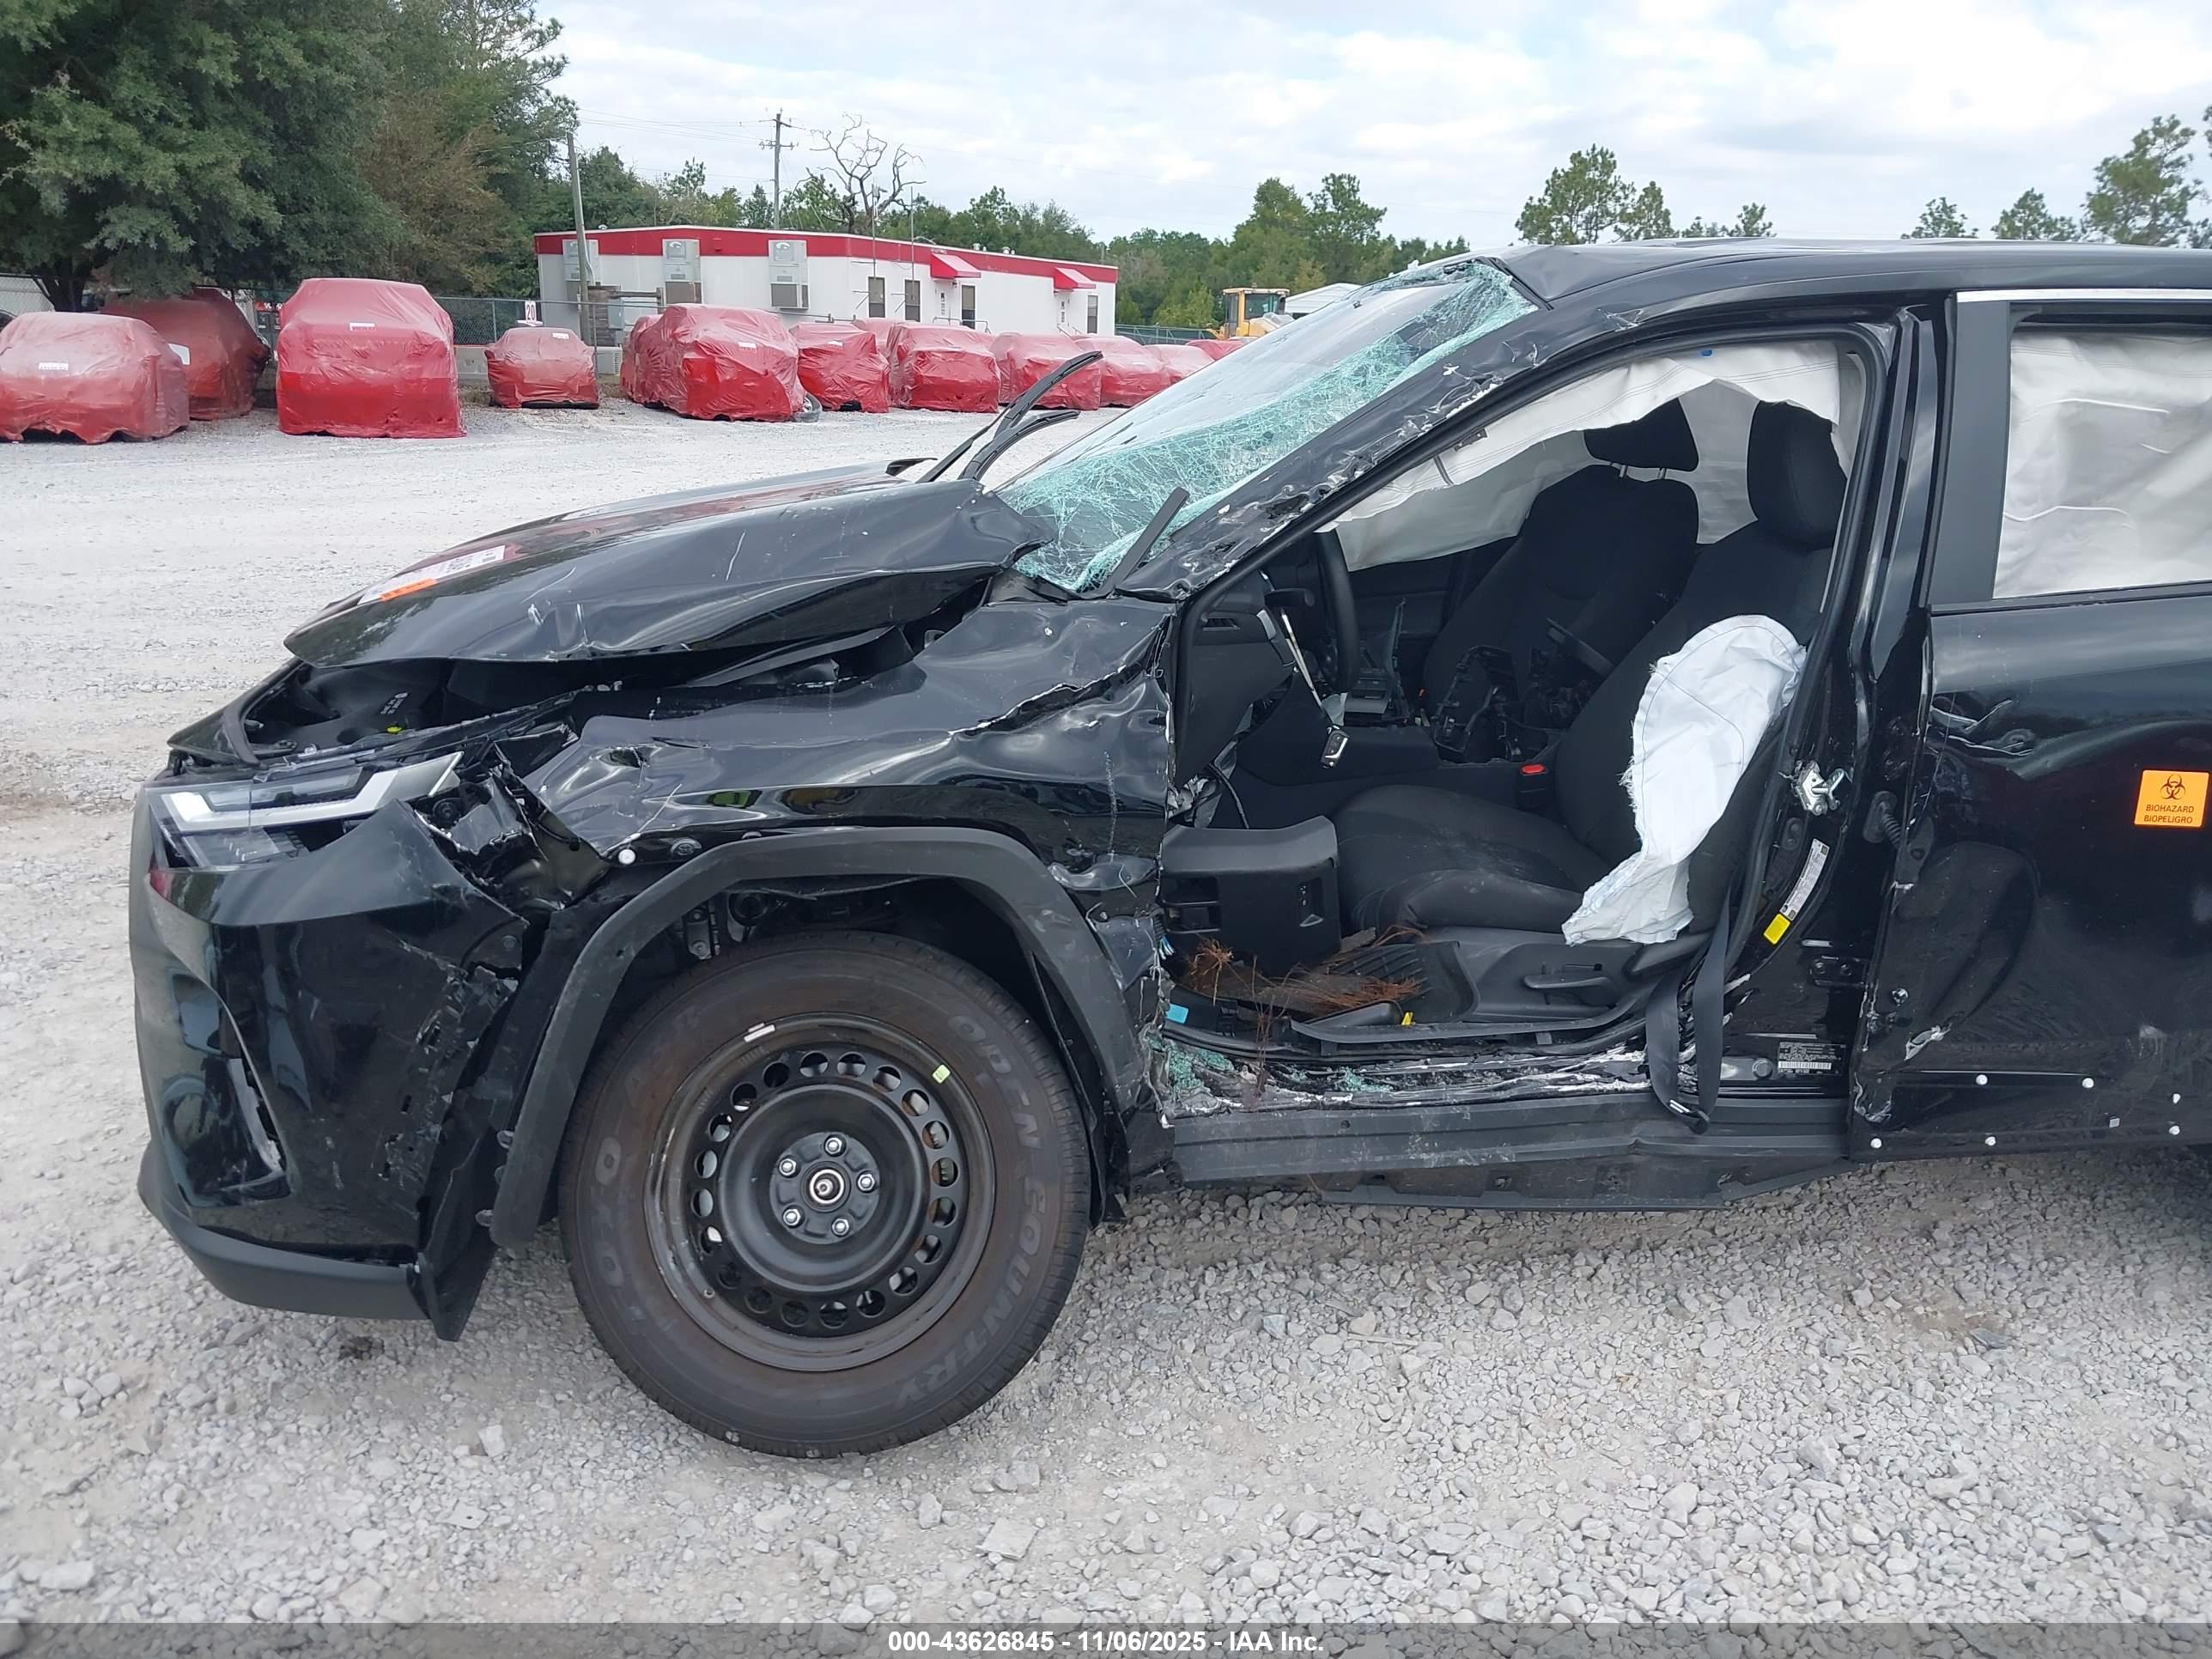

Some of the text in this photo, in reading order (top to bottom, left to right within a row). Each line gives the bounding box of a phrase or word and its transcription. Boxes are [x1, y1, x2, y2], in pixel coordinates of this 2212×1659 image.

[526, 304, 536, 320] 20
[2146, 804, 2195, 813] BIOHAZARD
[2143, 814, 2193, 824] BIOPELIGRO
